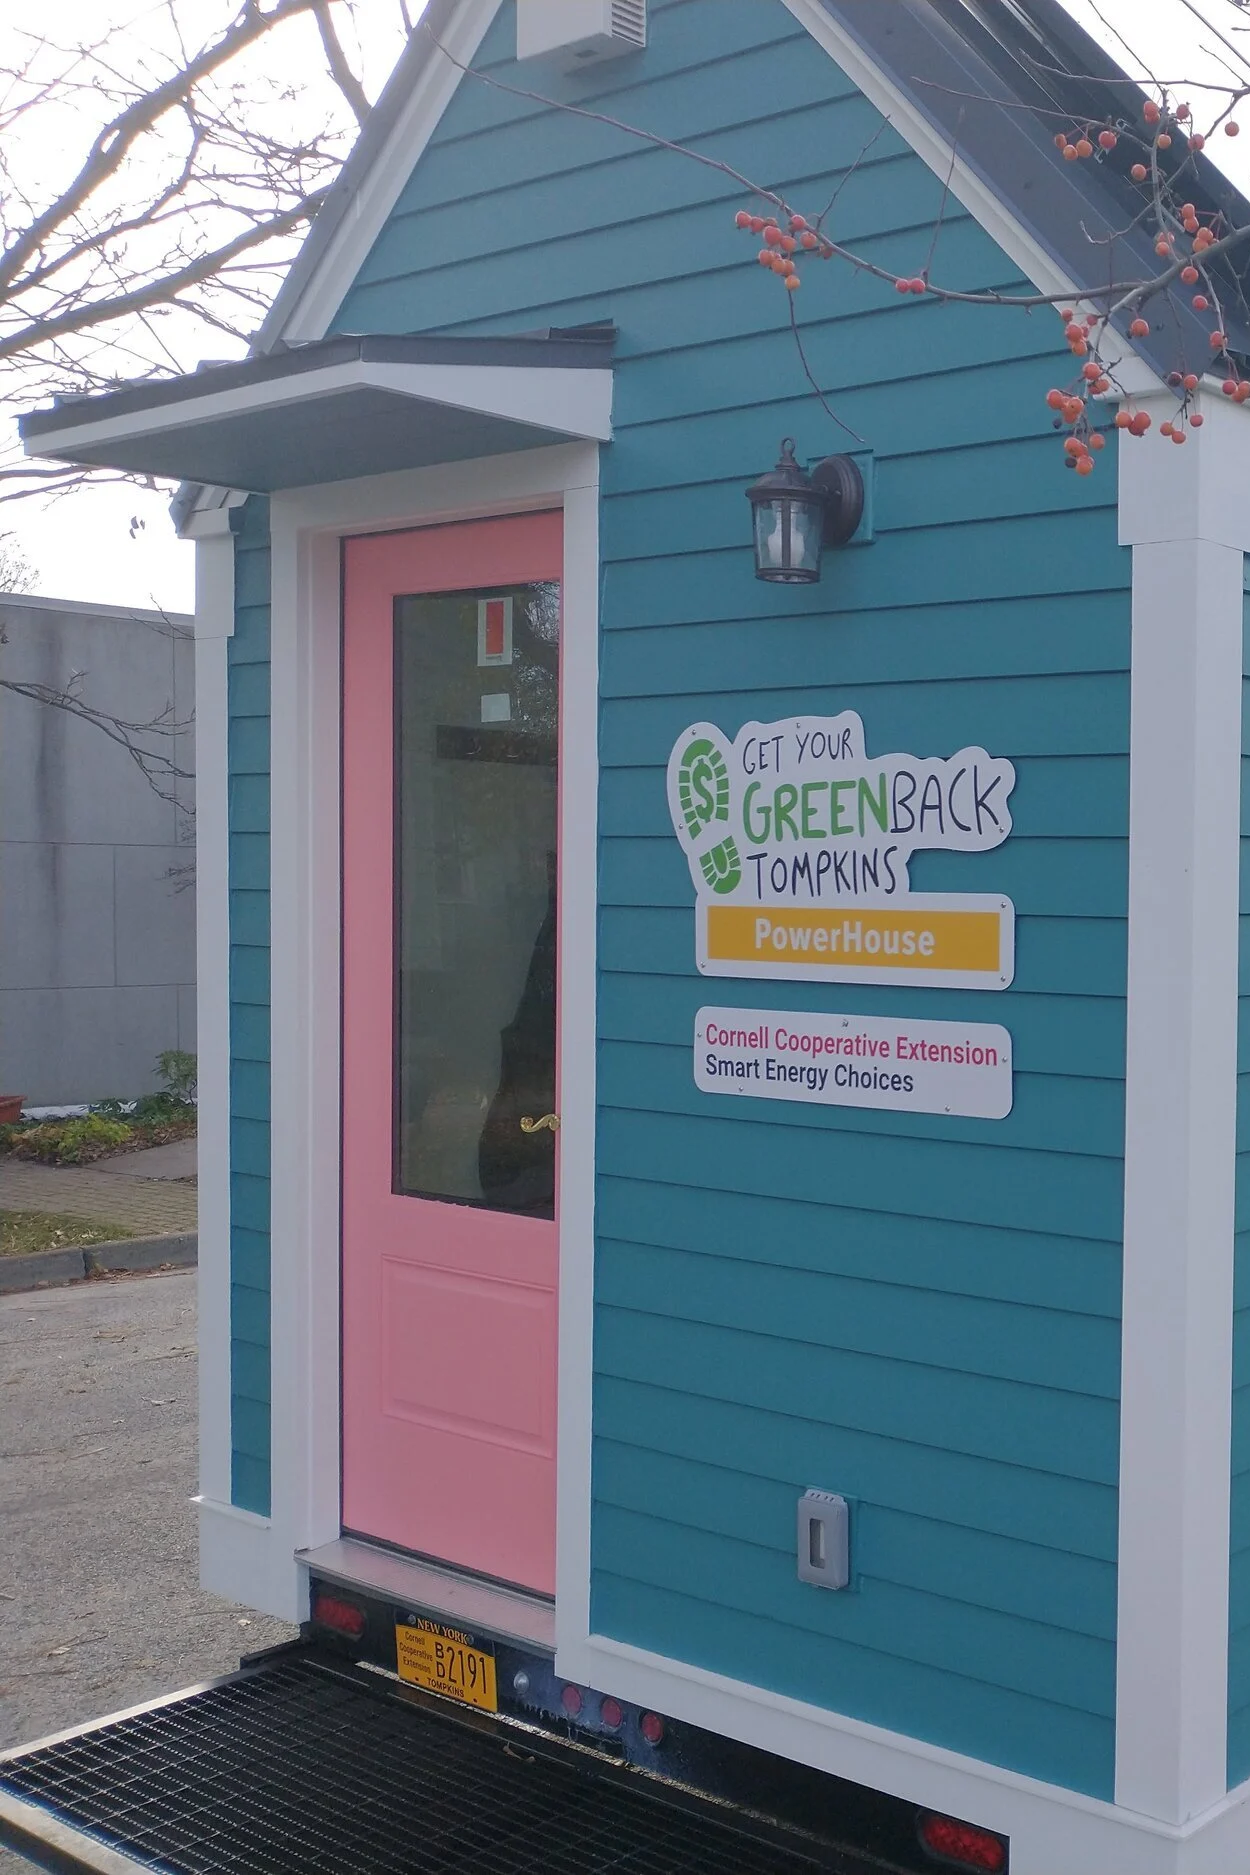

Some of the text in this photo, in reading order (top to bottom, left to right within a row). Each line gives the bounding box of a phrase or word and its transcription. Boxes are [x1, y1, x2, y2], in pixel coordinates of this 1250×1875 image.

[743, 727, 854, 776] GET YOUR
[743, 764, 1002, 845] GREENBACK
[746, 845, 899, 900] TOMPKINS
[754, 917, 936, 957] PowerHouse
[705, 1022, 998, 1067] Cornell Cooperative Extension
[705, 1053, 914, 1093] Smart Energy Choices
[404, 1631, 426, 1646] Cornell
[417, 1617, 469, 1645] NEW YORK
[399, 1641, 434, 1662] Cooperative
[402, 1655, 432, 1674] Extension
[426, 1676, 466, 1698] TOMPKINS
